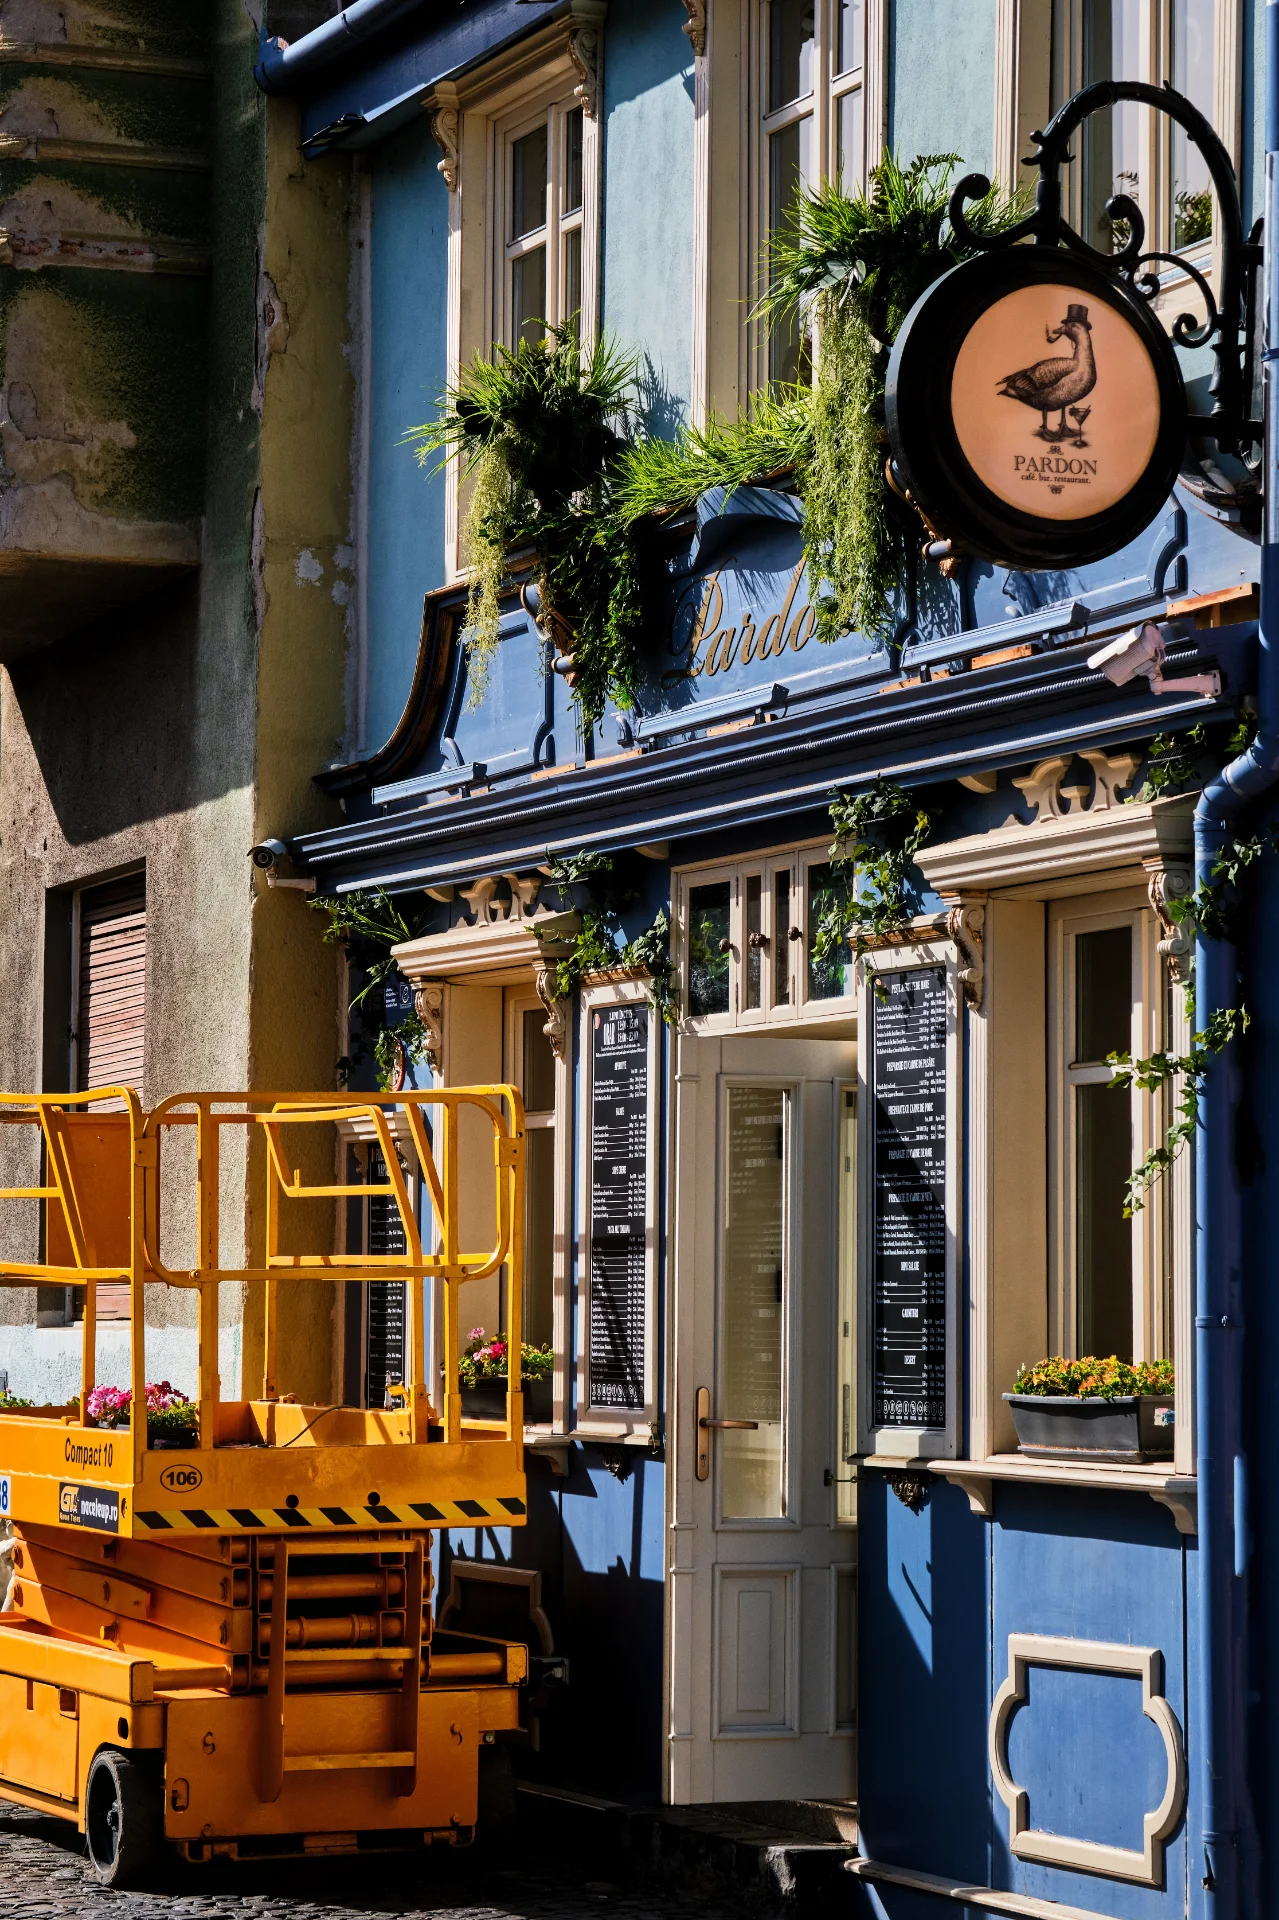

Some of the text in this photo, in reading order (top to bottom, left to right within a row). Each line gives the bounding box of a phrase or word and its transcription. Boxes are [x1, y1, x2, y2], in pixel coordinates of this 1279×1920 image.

[1014, 455, 1097, 476] PARDON
[1039, 473, 1052, 482] bar.
[661, 557, 849, 690] Pardo
[65, 1438, 113, 1470] Compact 10
[166, 1471, 198, 1486] 106
